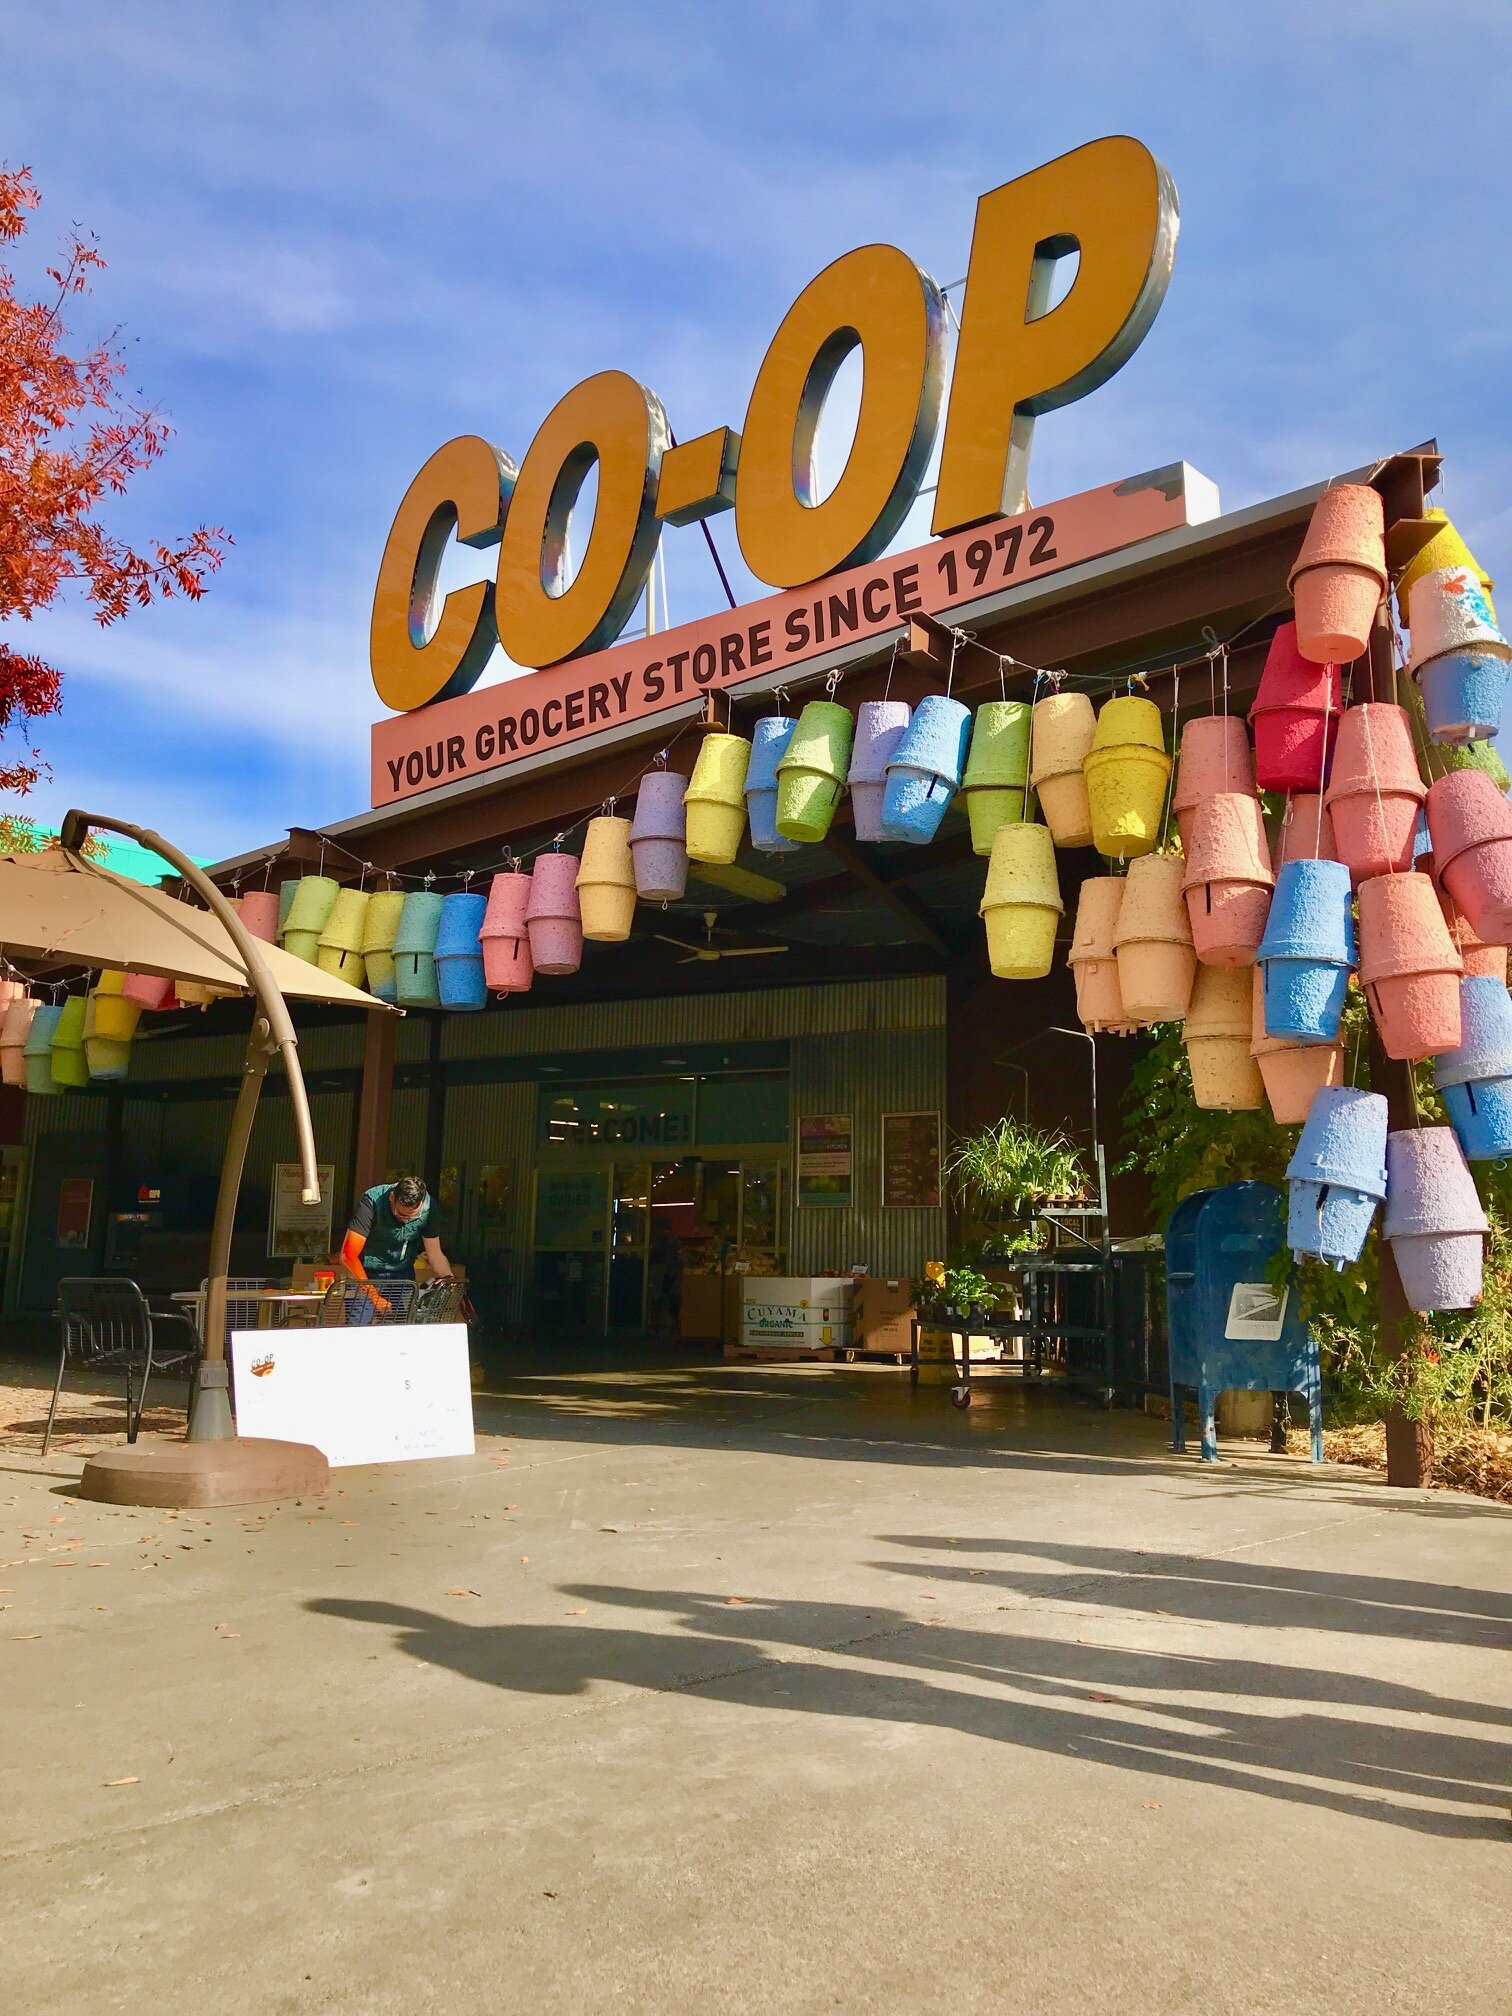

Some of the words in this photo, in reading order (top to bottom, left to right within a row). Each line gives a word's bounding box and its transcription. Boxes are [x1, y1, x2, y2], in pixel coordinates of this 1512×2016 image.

[370, 135, 1168, 710] CO-OP
[387, 735, 466, 793] YOUR
[475, 671, 633, 761] GROCERY
[643, 621, 773, 703] STORE
[784, 564, 922, 653] SINCE
[937, 515, 1058, 597] 1972
[1060, 1217, 1081, 1227] LOCAL
[747, 1306, 806, 1322] CUYAMA
[759, 1319, 794, 1329] ORGANIC
[251, 1353, 274, 1369] CO-OP
